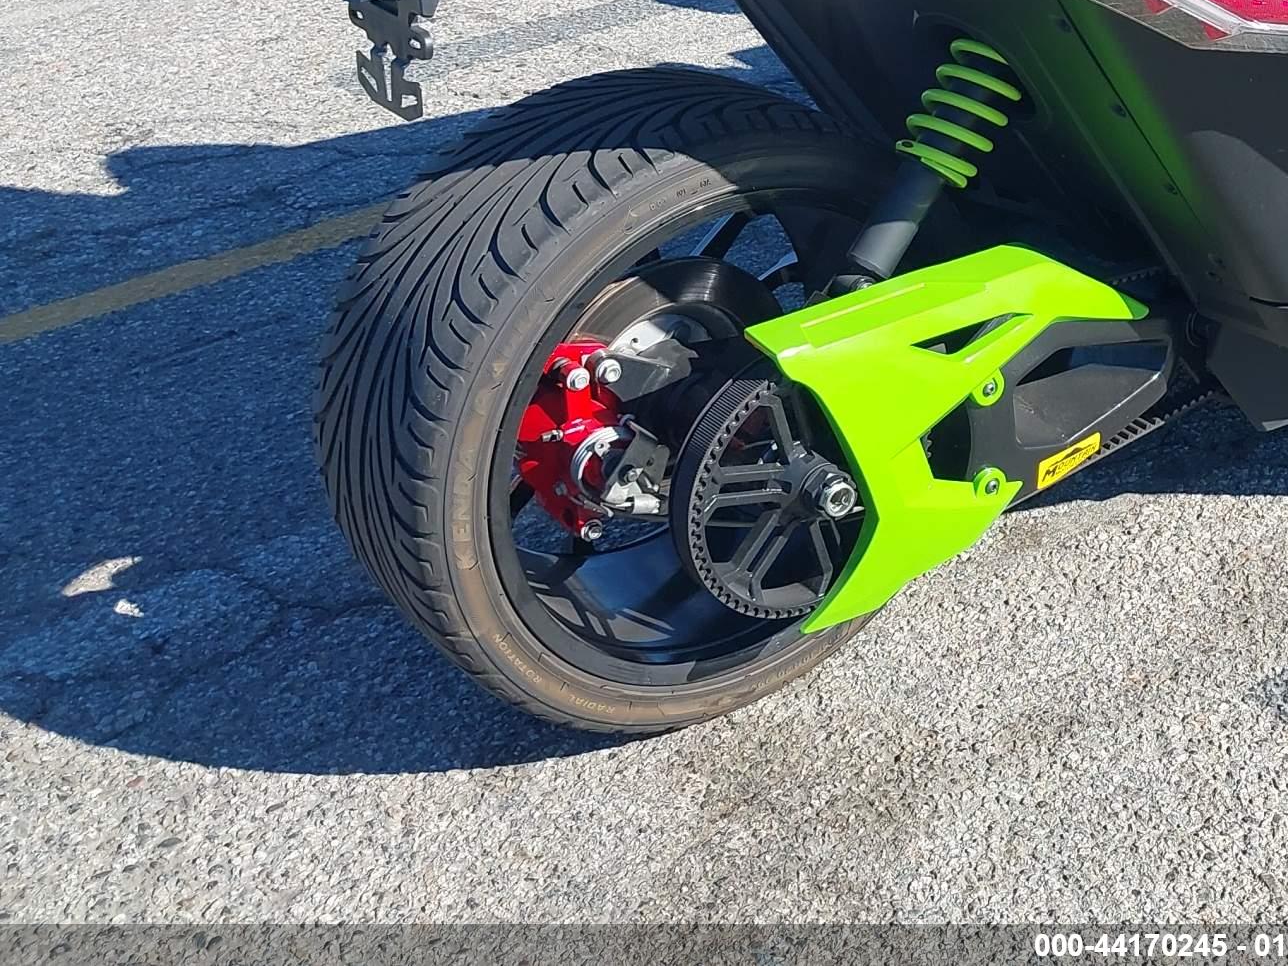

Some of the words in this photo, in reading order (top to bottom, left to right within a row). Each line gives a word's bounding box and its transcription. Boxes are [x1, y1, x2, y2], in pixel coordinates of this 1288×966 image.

[454, 446, 477, 570] KENDA
[492, 633, 543, 684] ROTATION
[566, 693, 616, 715] RADIAL
